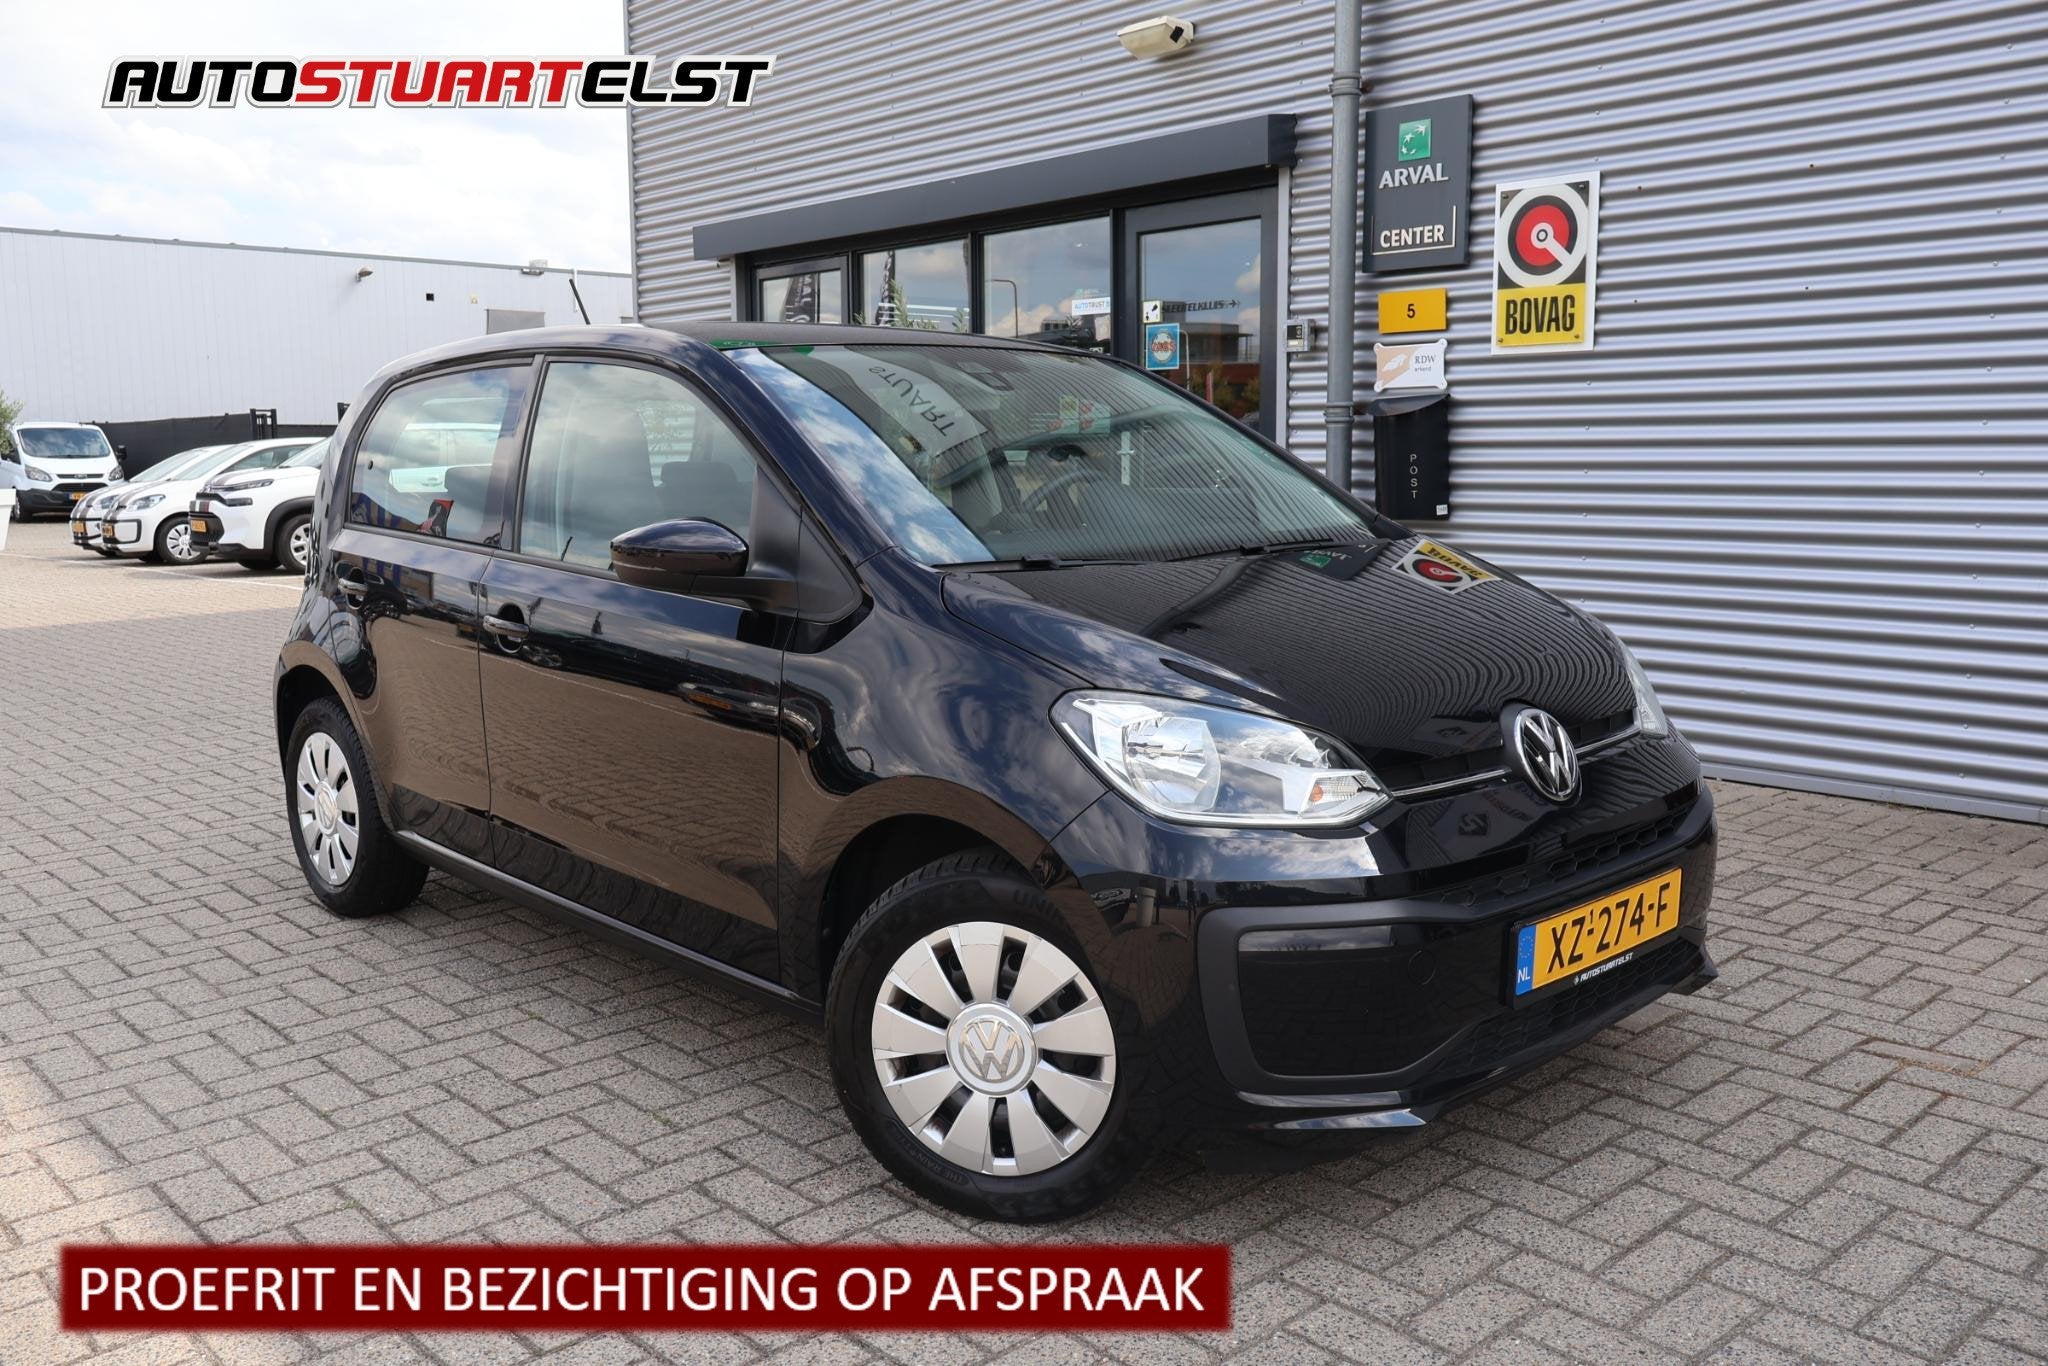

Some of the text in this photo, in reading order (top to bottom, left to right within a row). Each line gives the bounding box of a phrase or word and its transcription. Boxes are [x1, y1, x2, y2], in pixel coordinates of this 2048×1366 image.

[1378, 163, 1449, 190] ARVAL
[1379, 223, 1445, 249] CENTER
[1406, 302, 1416, 319] 5
[1504, 294, 1576, 335] BOVAG
[1415, 355, 1436, 364] RDW
[1409, 453, 1419, 499] POST
[1547, 882, 1671, 974] XZ-274-F
[1517, 966, 1531, 983] NL
